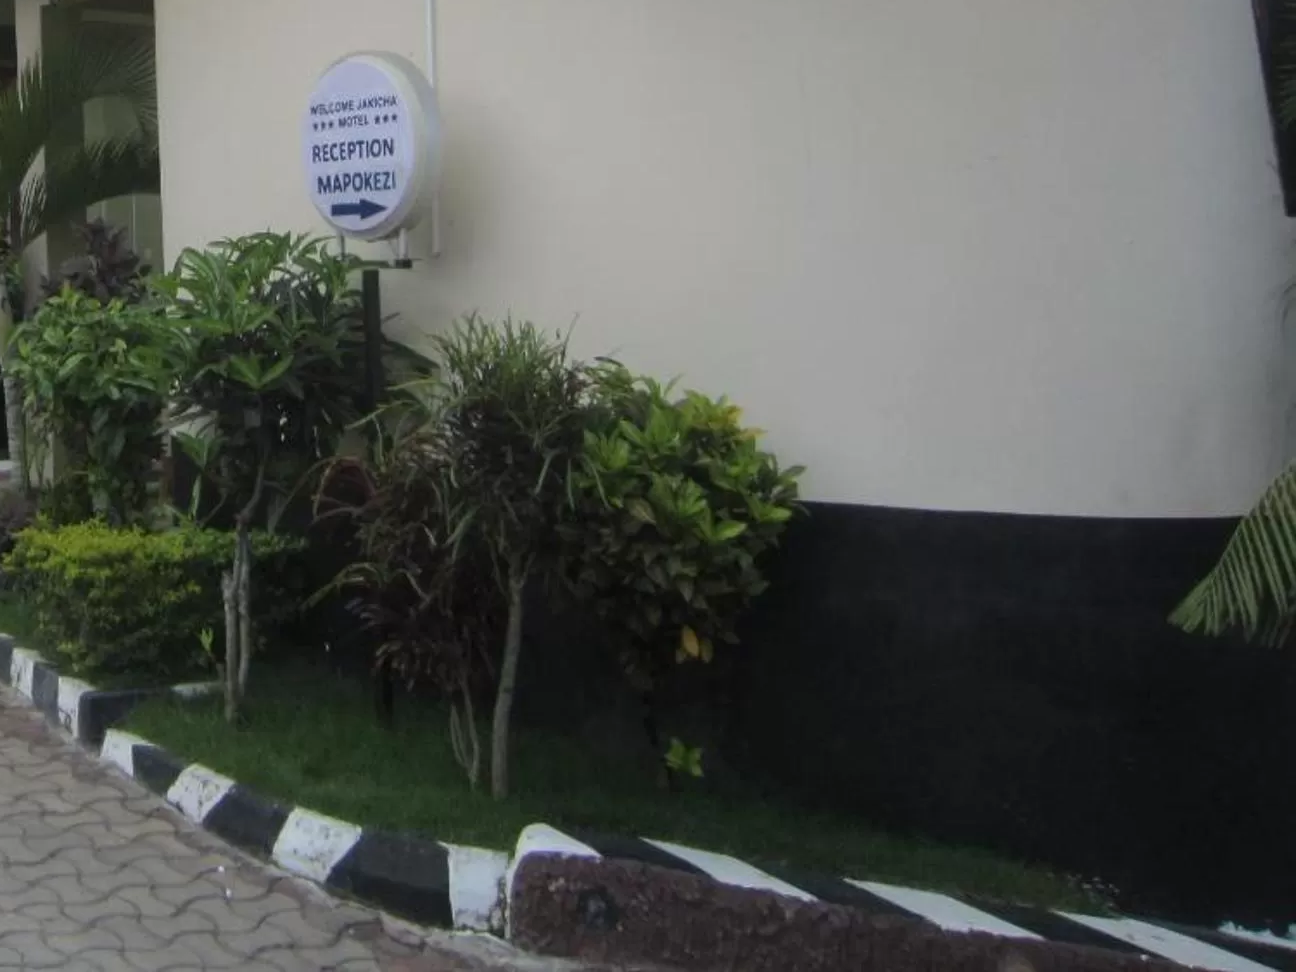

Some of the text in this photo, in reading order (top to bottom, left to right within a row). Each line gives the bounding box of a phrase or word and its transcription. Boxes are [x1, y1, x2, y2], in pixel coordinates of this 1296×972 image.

[310, 100, 354, 115] WELCOME
[338, 115, 369, 127] MOTEL
[312, 138, 394, 163] RECEPTION
[317, 171, 396, 194] MAPOKEZI
